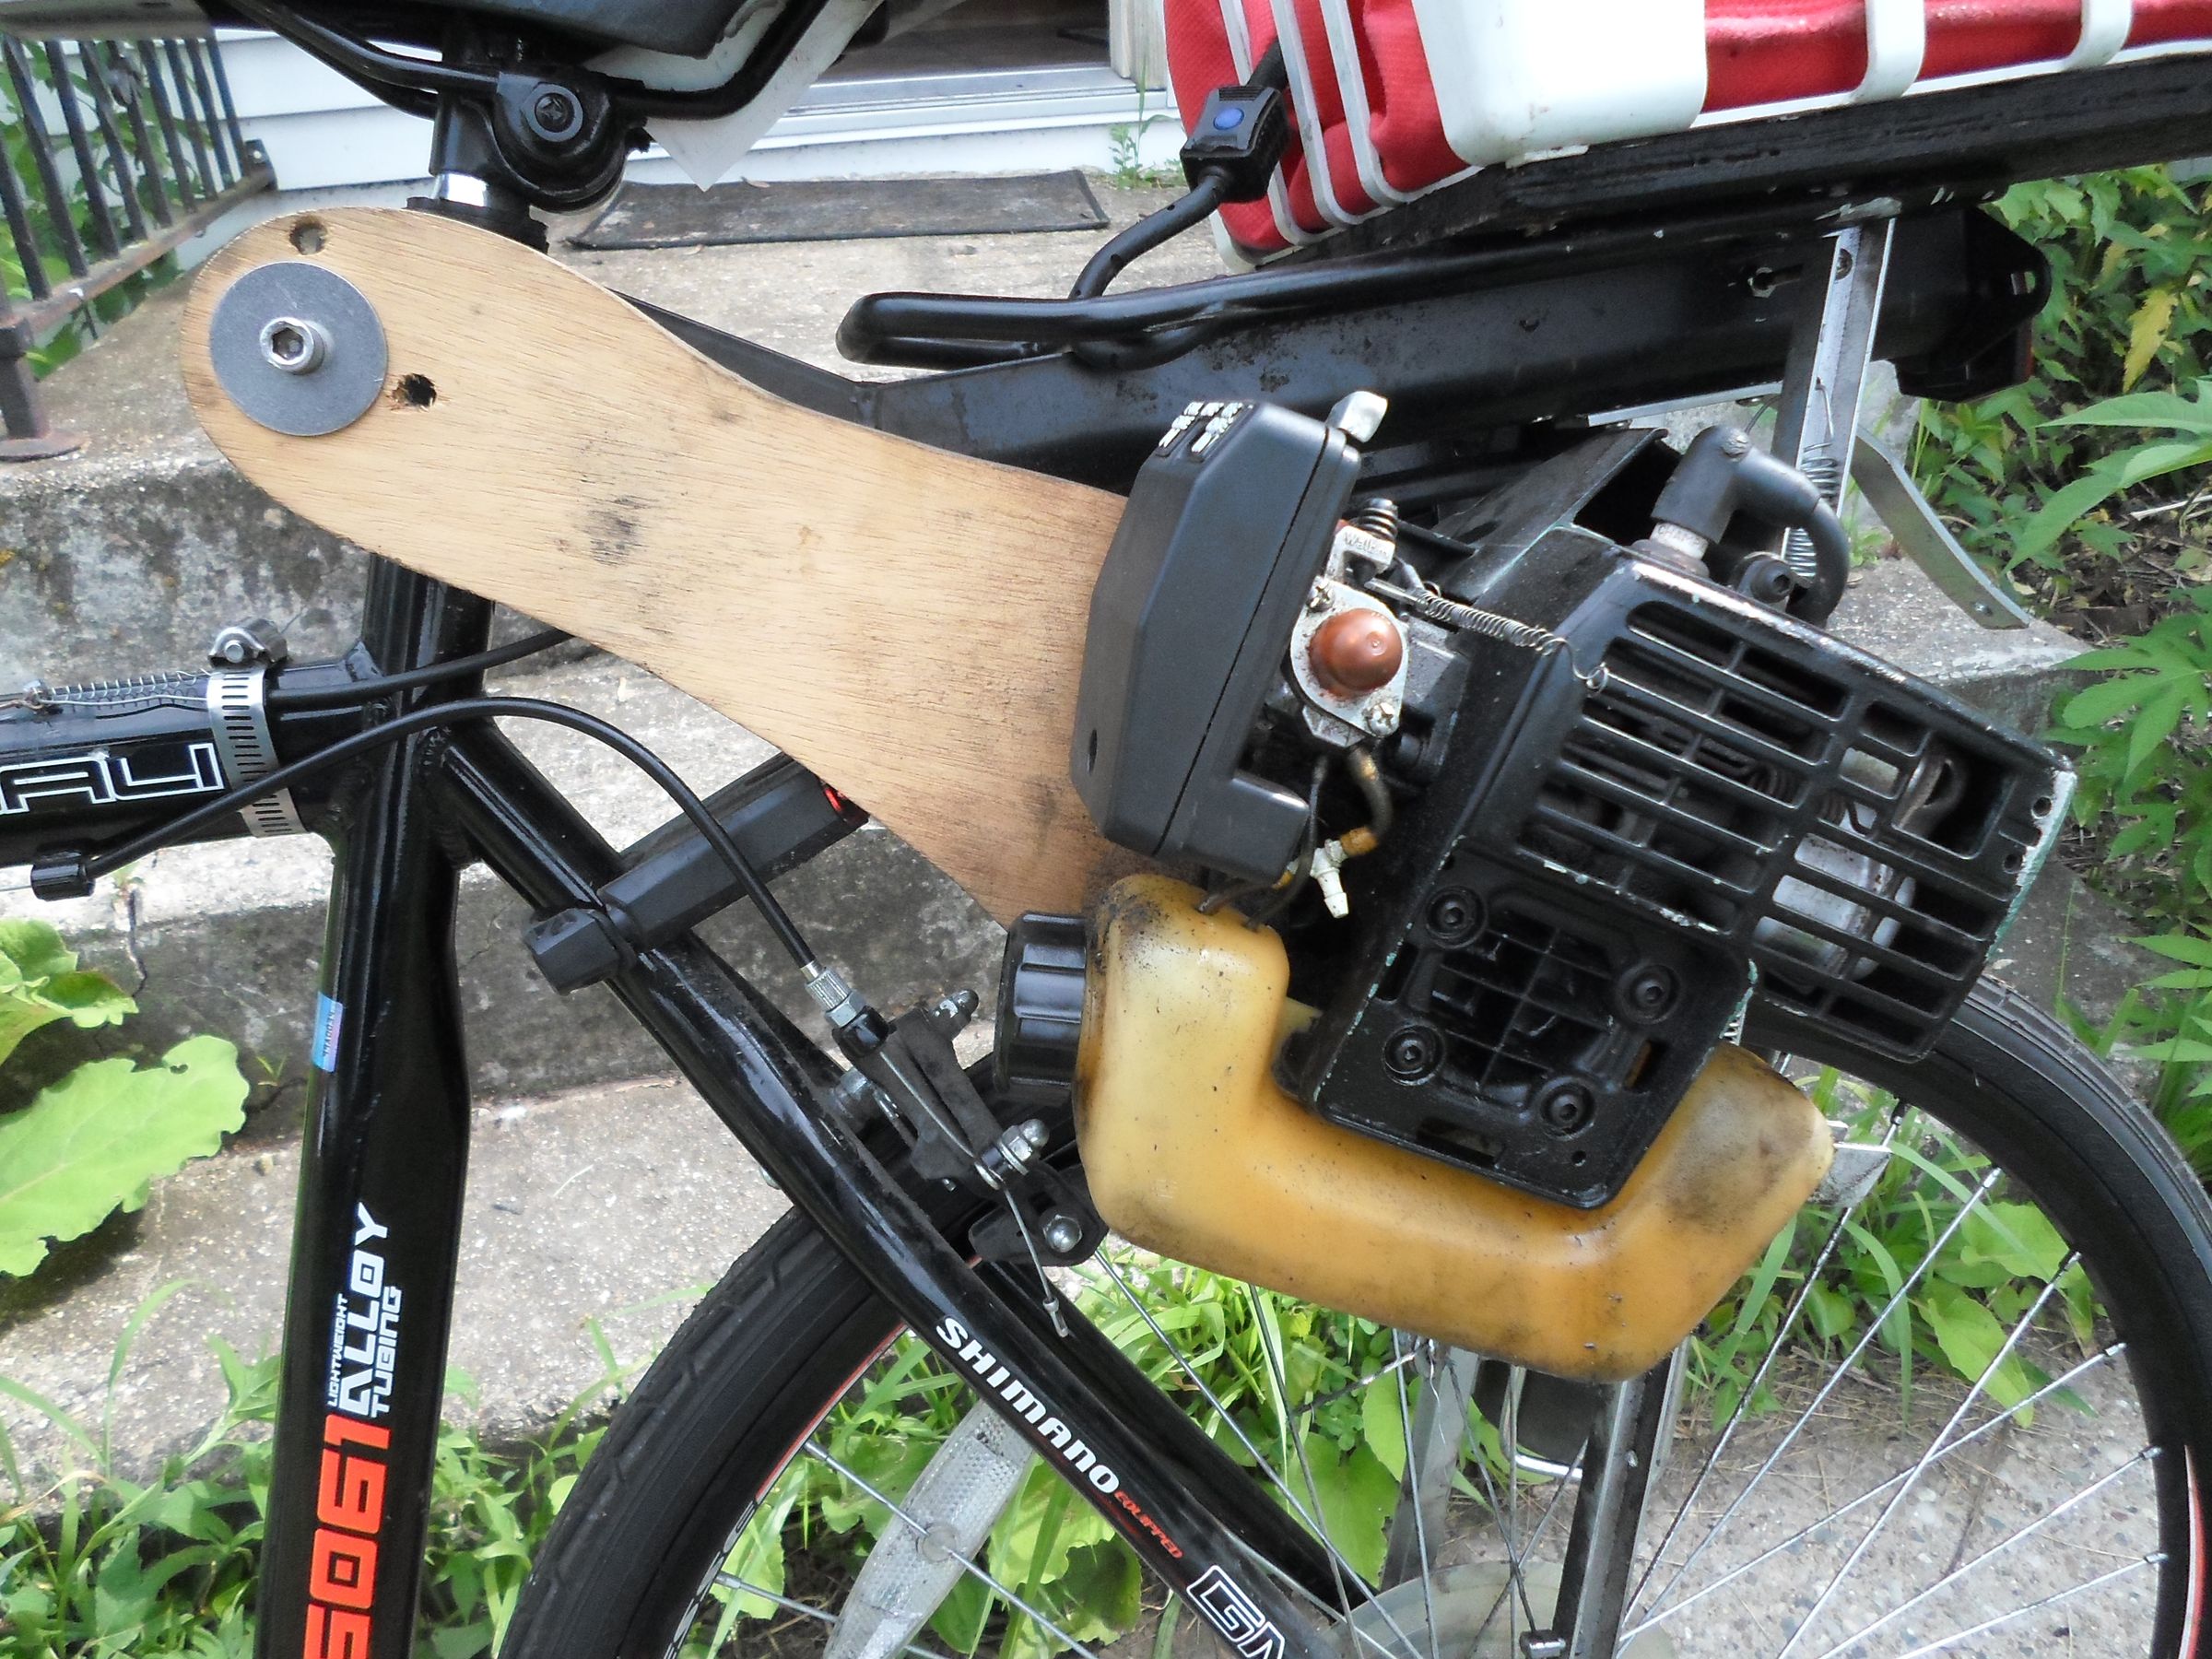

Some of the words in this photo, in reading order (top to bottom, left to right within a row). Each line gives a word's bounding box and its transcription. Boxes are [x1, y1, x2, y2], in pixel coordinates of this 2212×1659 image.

[327, 1293, 348, 1407] LIGHTWEIGHT
[338, 1201, 388, 1417] ALLOY
[371, 1286, 402, 1418] TUBING
[935, 1317, 1121, 1494] SHIMANO
